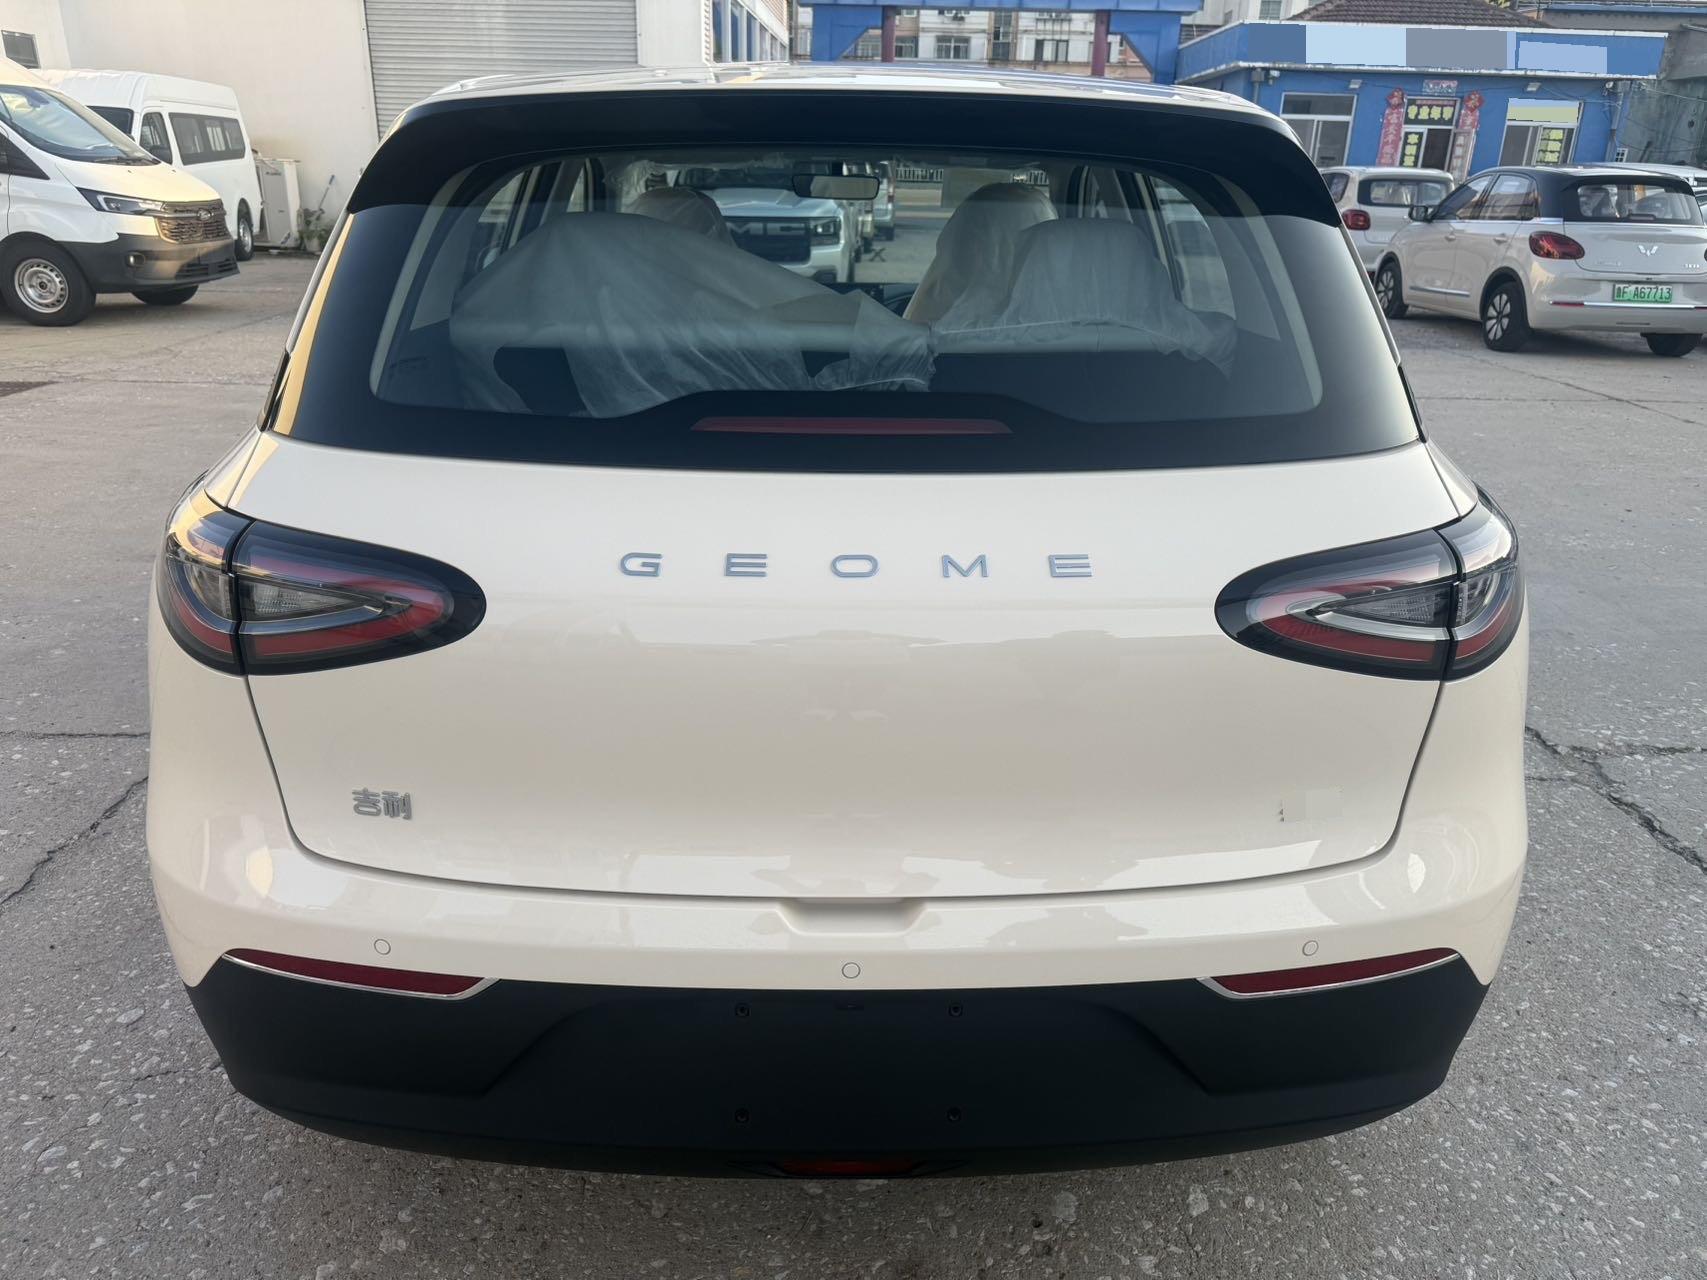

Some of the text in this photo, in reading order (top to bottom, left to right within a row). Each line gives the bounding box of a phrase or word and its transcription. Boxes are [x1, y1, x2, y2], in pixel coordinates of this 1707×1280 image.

[1632, 286, 1672, 300] A67713
[619, 552, 1093, 578] GEOME
[352, 787, 412, 820] 吉利
